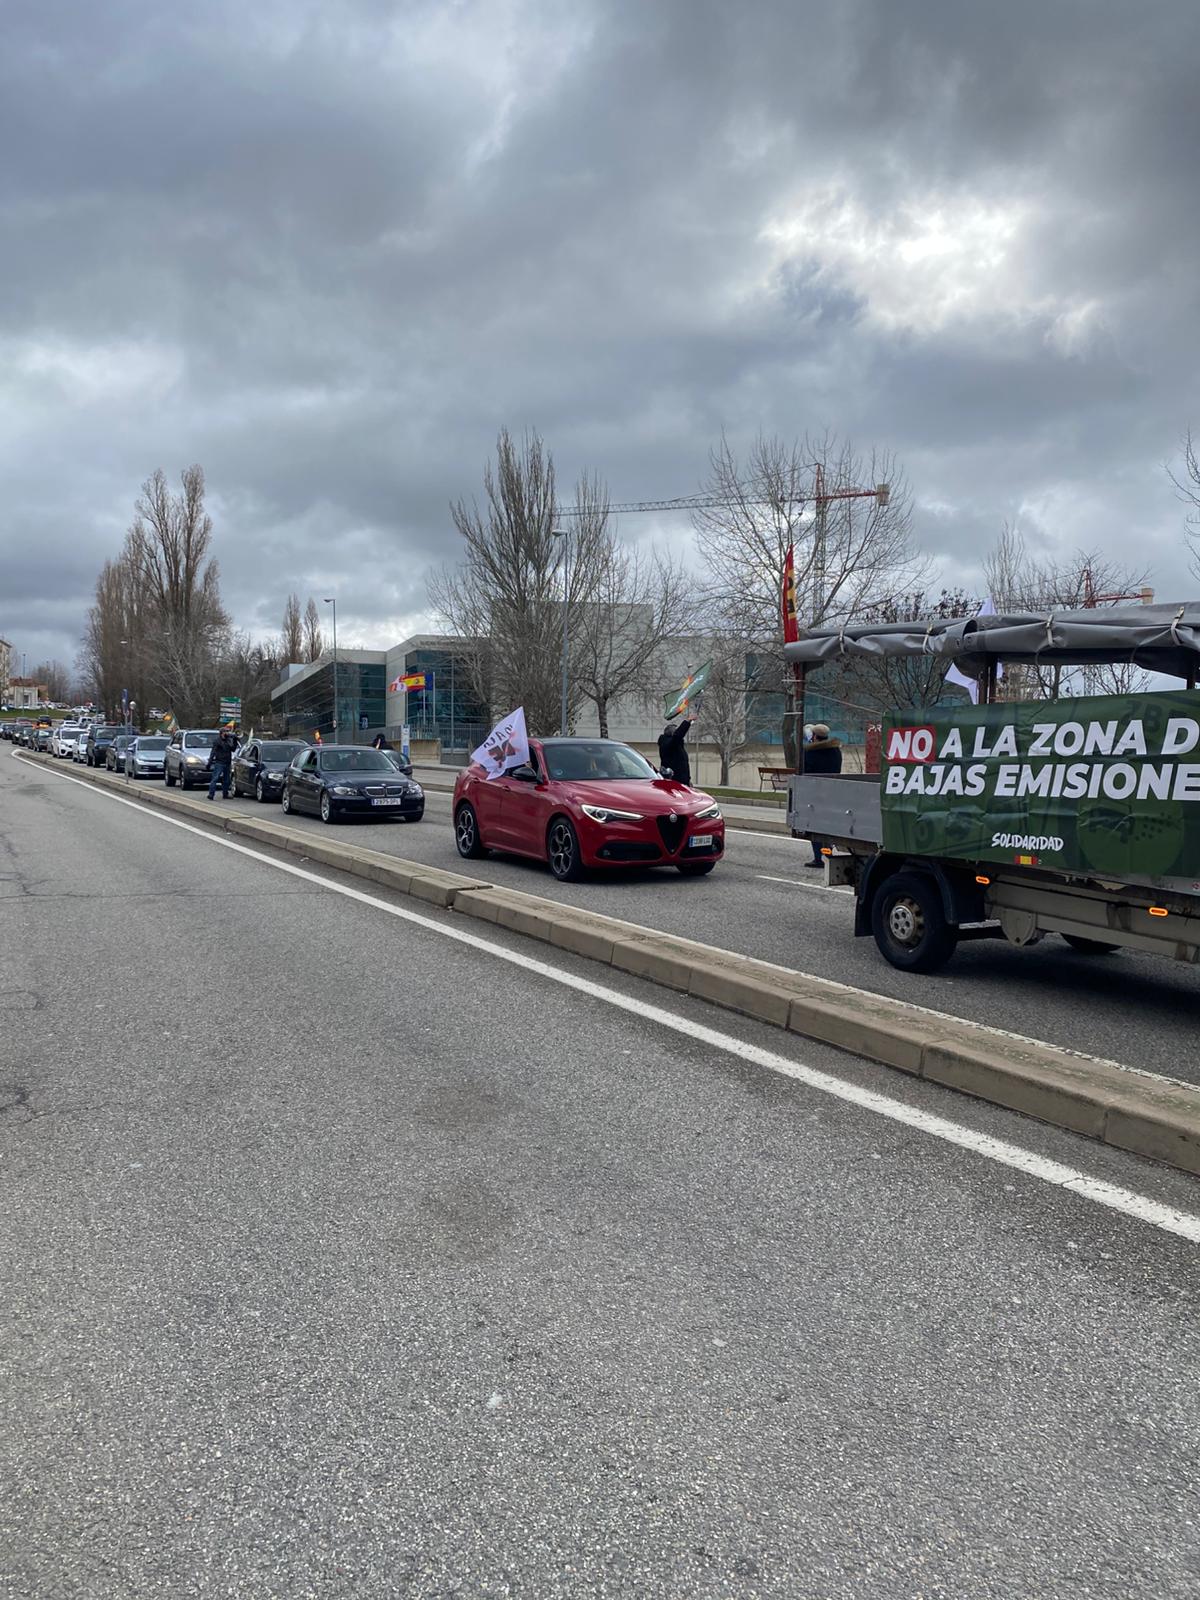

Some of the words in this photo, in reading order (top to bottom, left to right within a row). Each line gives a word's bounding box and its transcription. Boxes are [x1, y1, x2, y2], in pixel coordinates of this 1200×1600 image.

[888, 729, 933, 760] NO
[938, 727, 962, 758] A
[972, 725, 1018, 758] LA
[1027, 719, 1148, 757] ZONA
[885, 764, 988, 797] BAJAS
[991, 832, 1064, 852] SOLIDARIDAD
